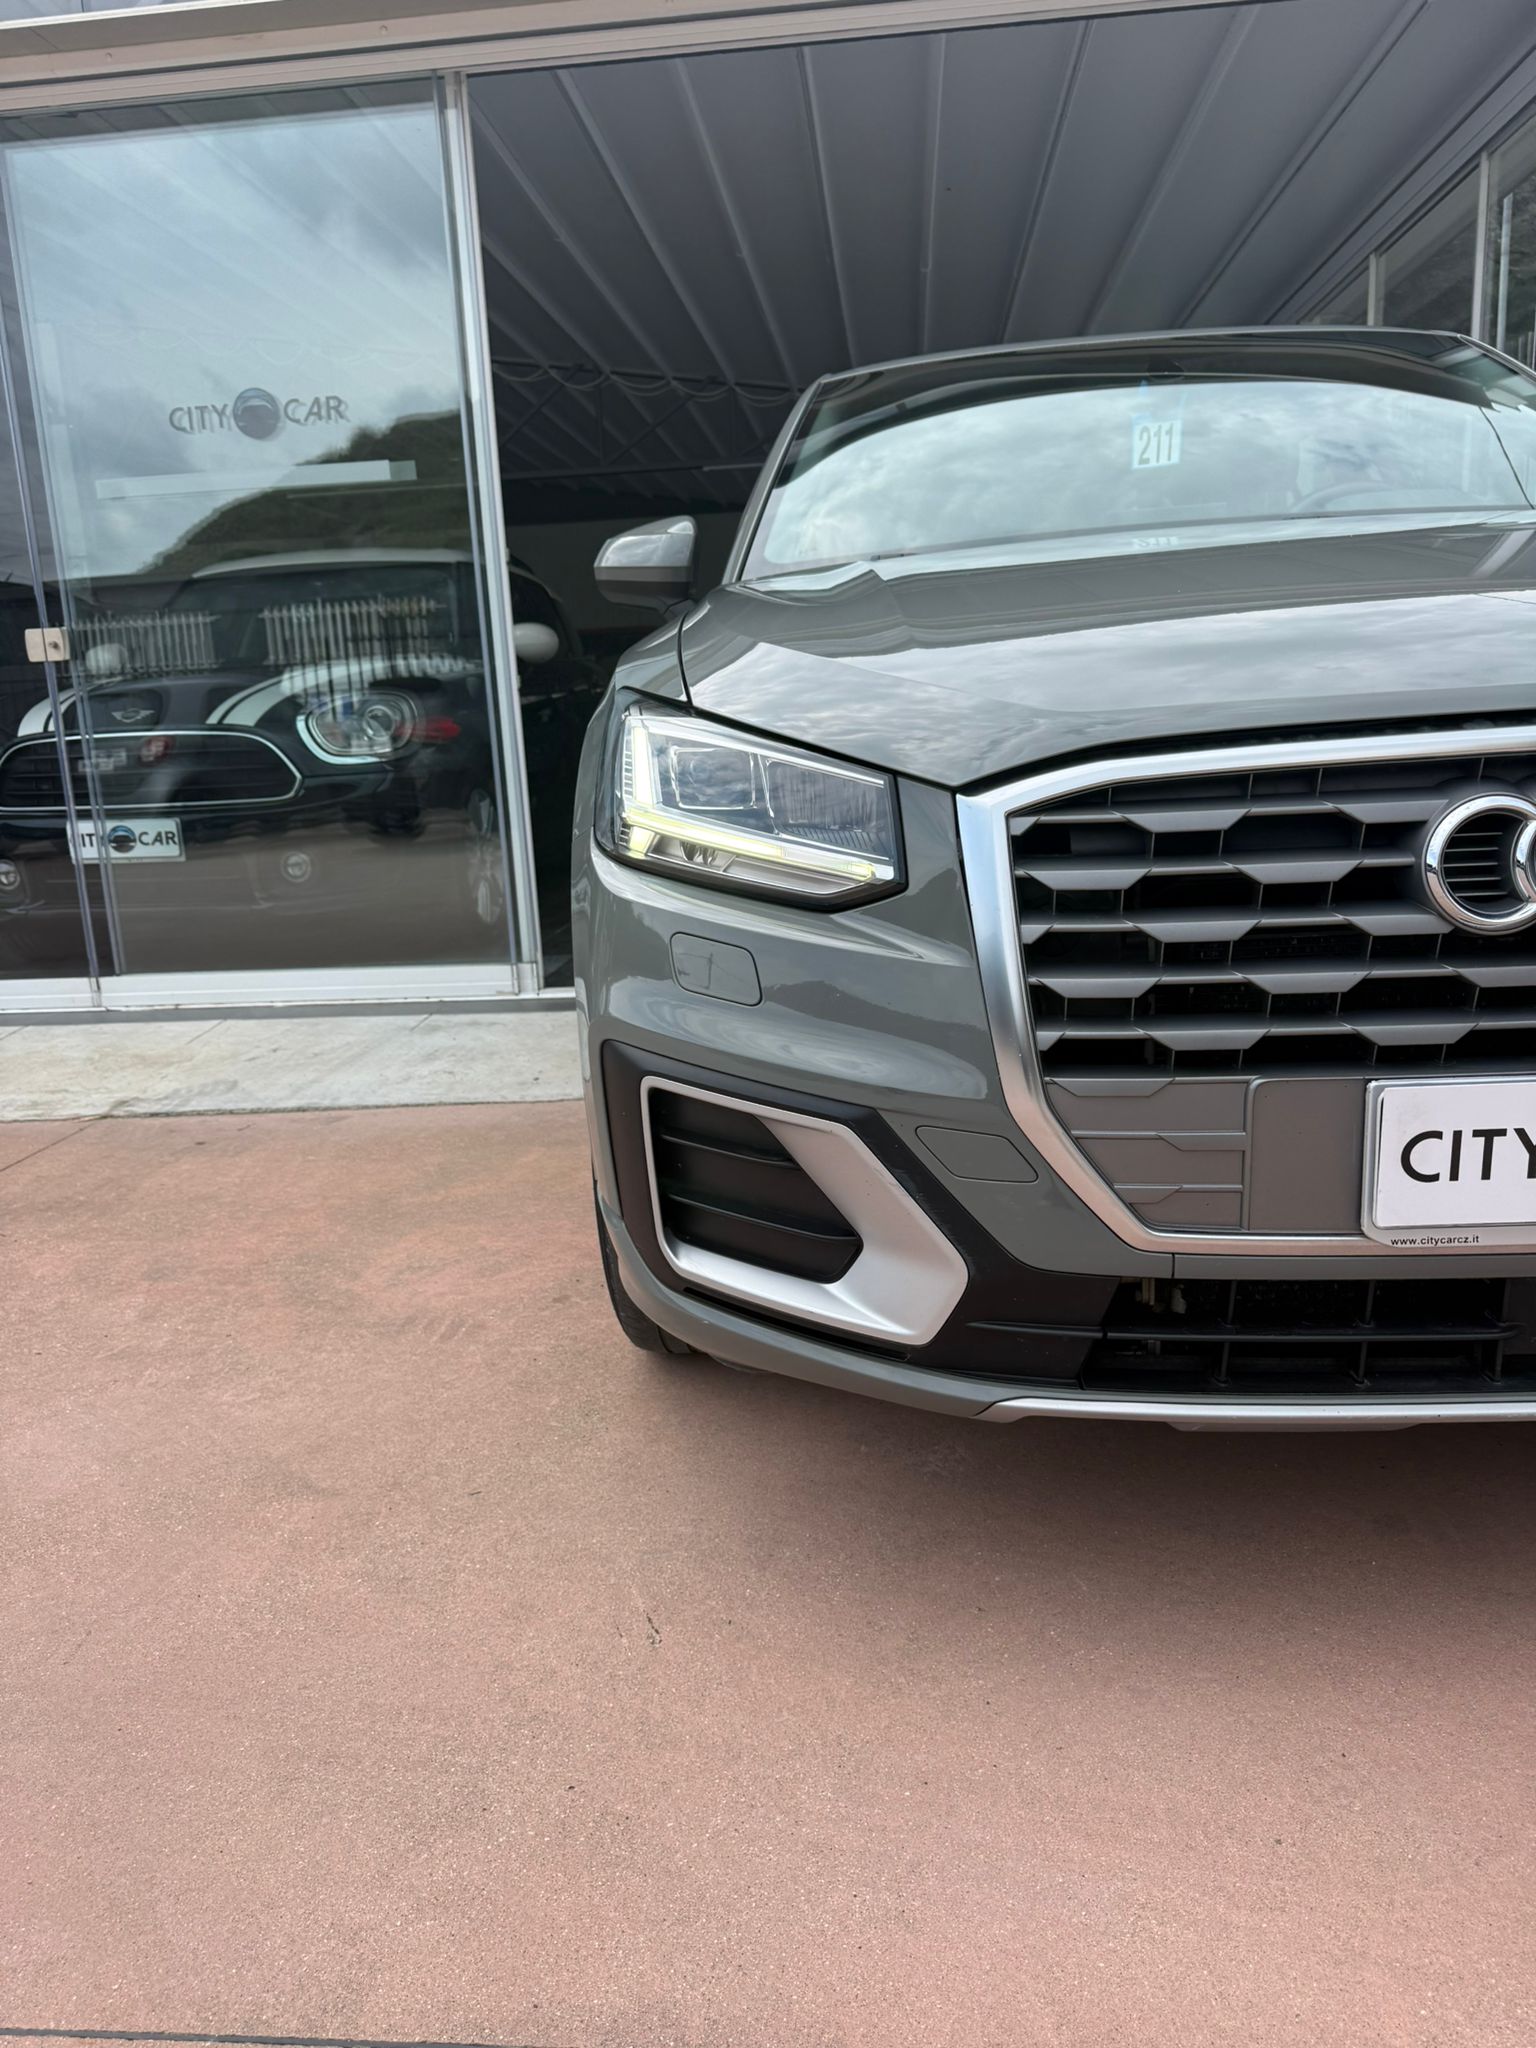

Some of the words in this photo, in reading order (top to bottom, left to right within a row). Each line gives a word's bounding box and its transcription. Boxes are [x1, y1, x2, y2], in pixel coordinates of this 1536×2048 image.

[169, 403, 230, 433] CITY
[283, 395, 347, 424] CAR
[1137, 422, 1174, 466] 211
[138, 831, 178, 846] CAR
[1390, 1234, 1480, 1247] www.citycarcz.it
